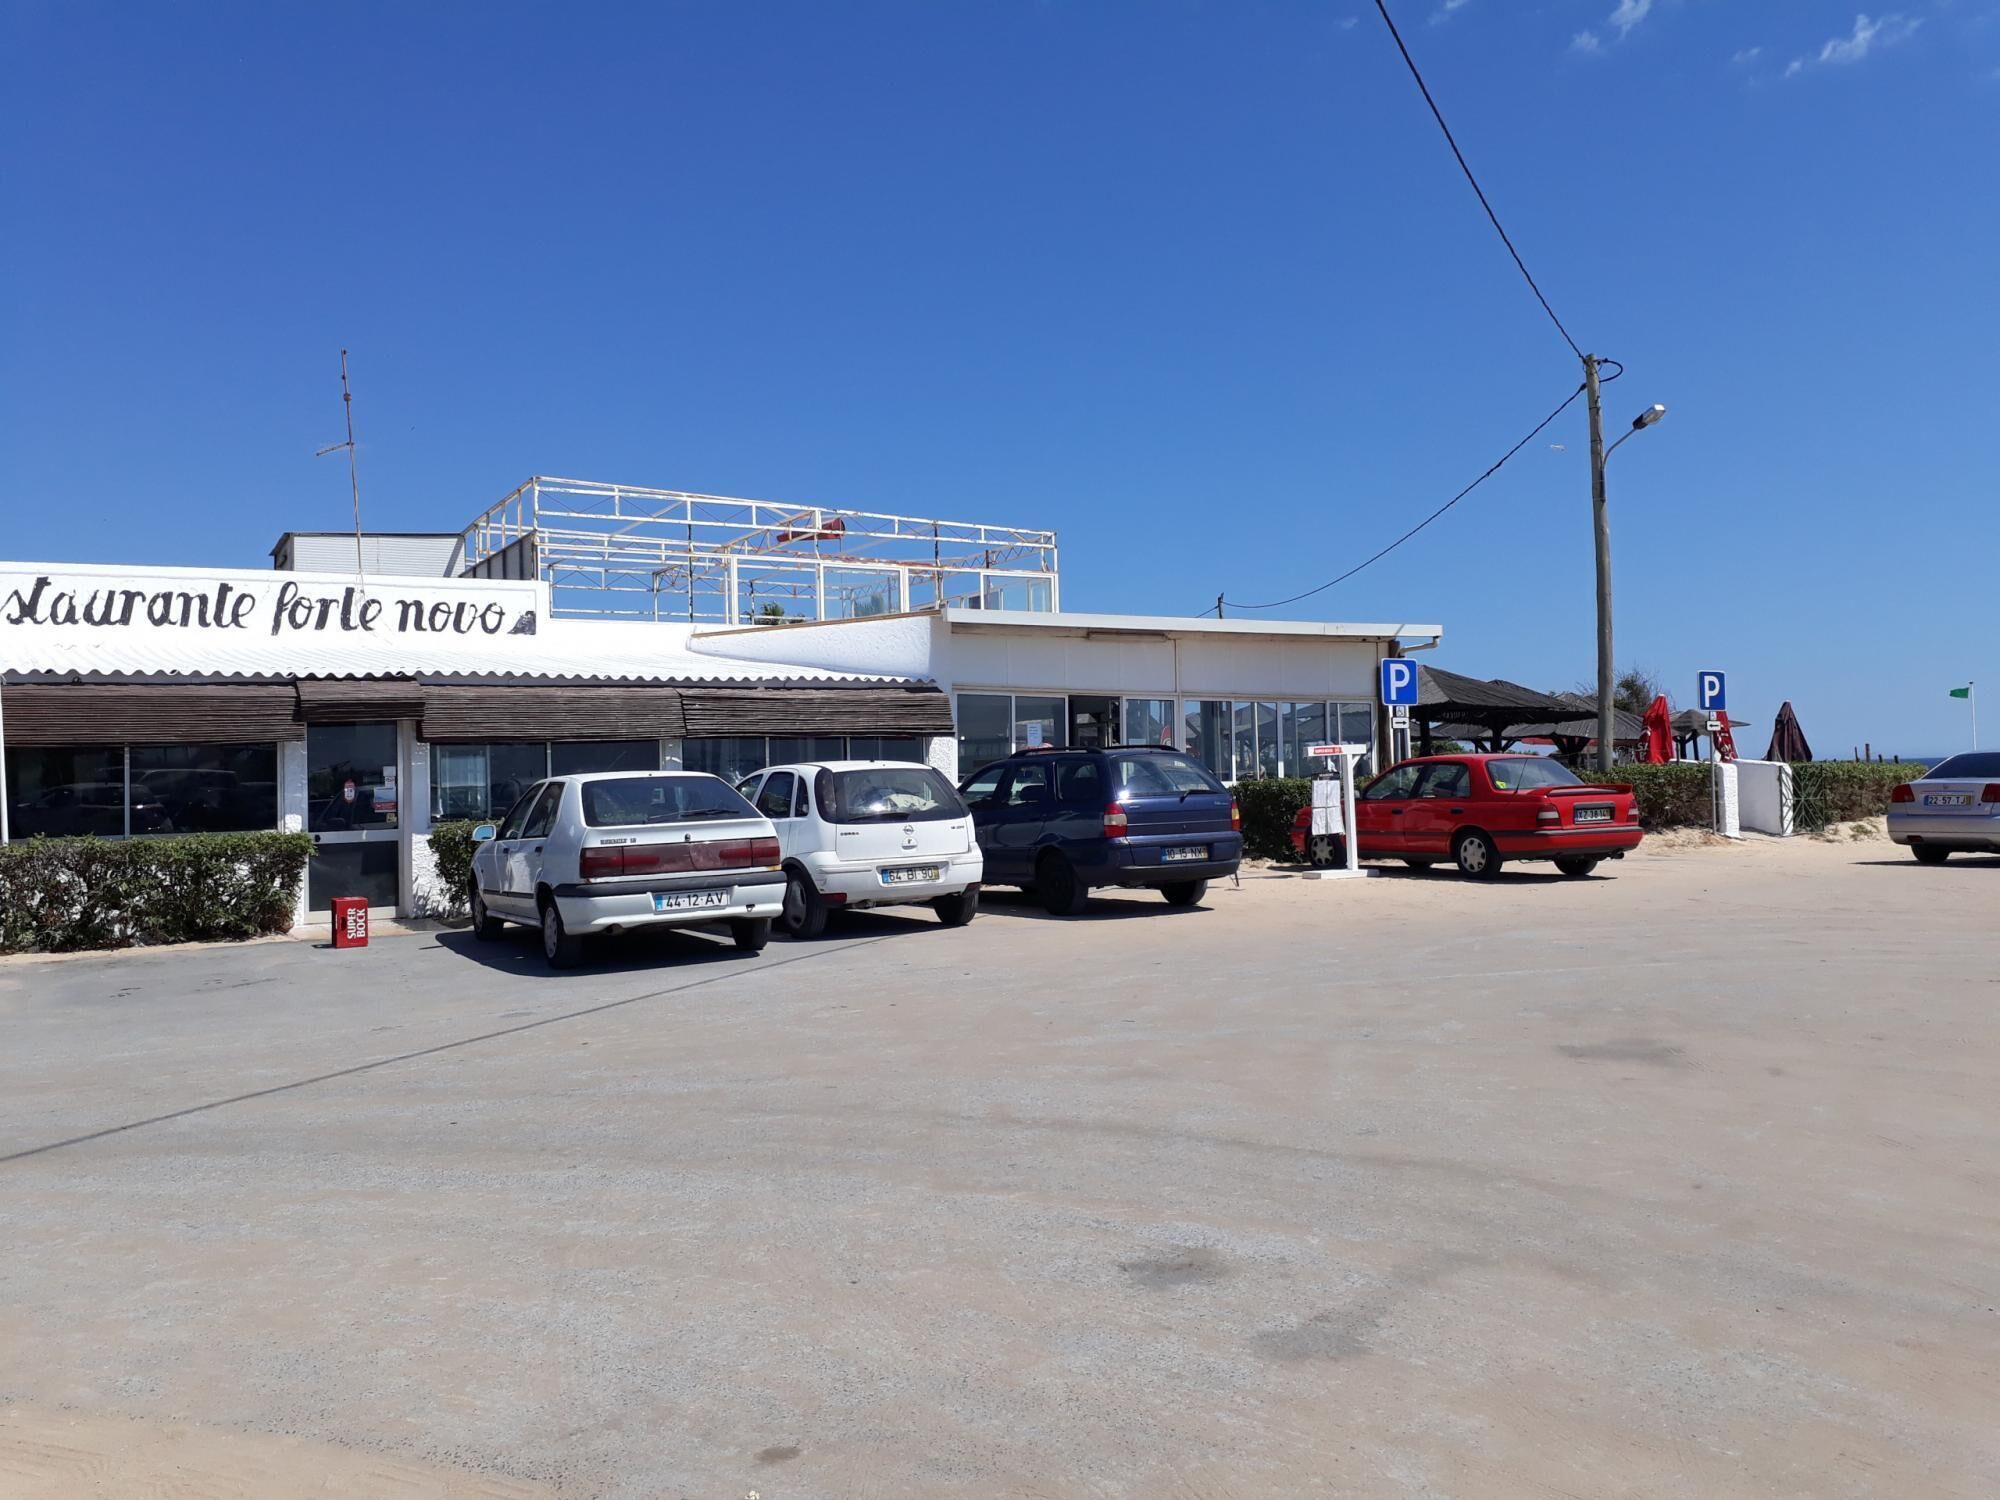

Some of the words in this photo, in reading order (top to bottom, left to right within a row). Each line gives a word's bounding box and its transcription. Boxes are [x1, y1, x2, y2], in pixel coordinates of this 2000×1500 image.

[271, 581, 382, 636] forte
[395, 599, 506, 634] novo
[1389, 663, 1410, 701] P
[1703, 675, 1720, 708] P
[347, 907, 356, 939] SUPER
[356, 908, 365, 938] BOCK
